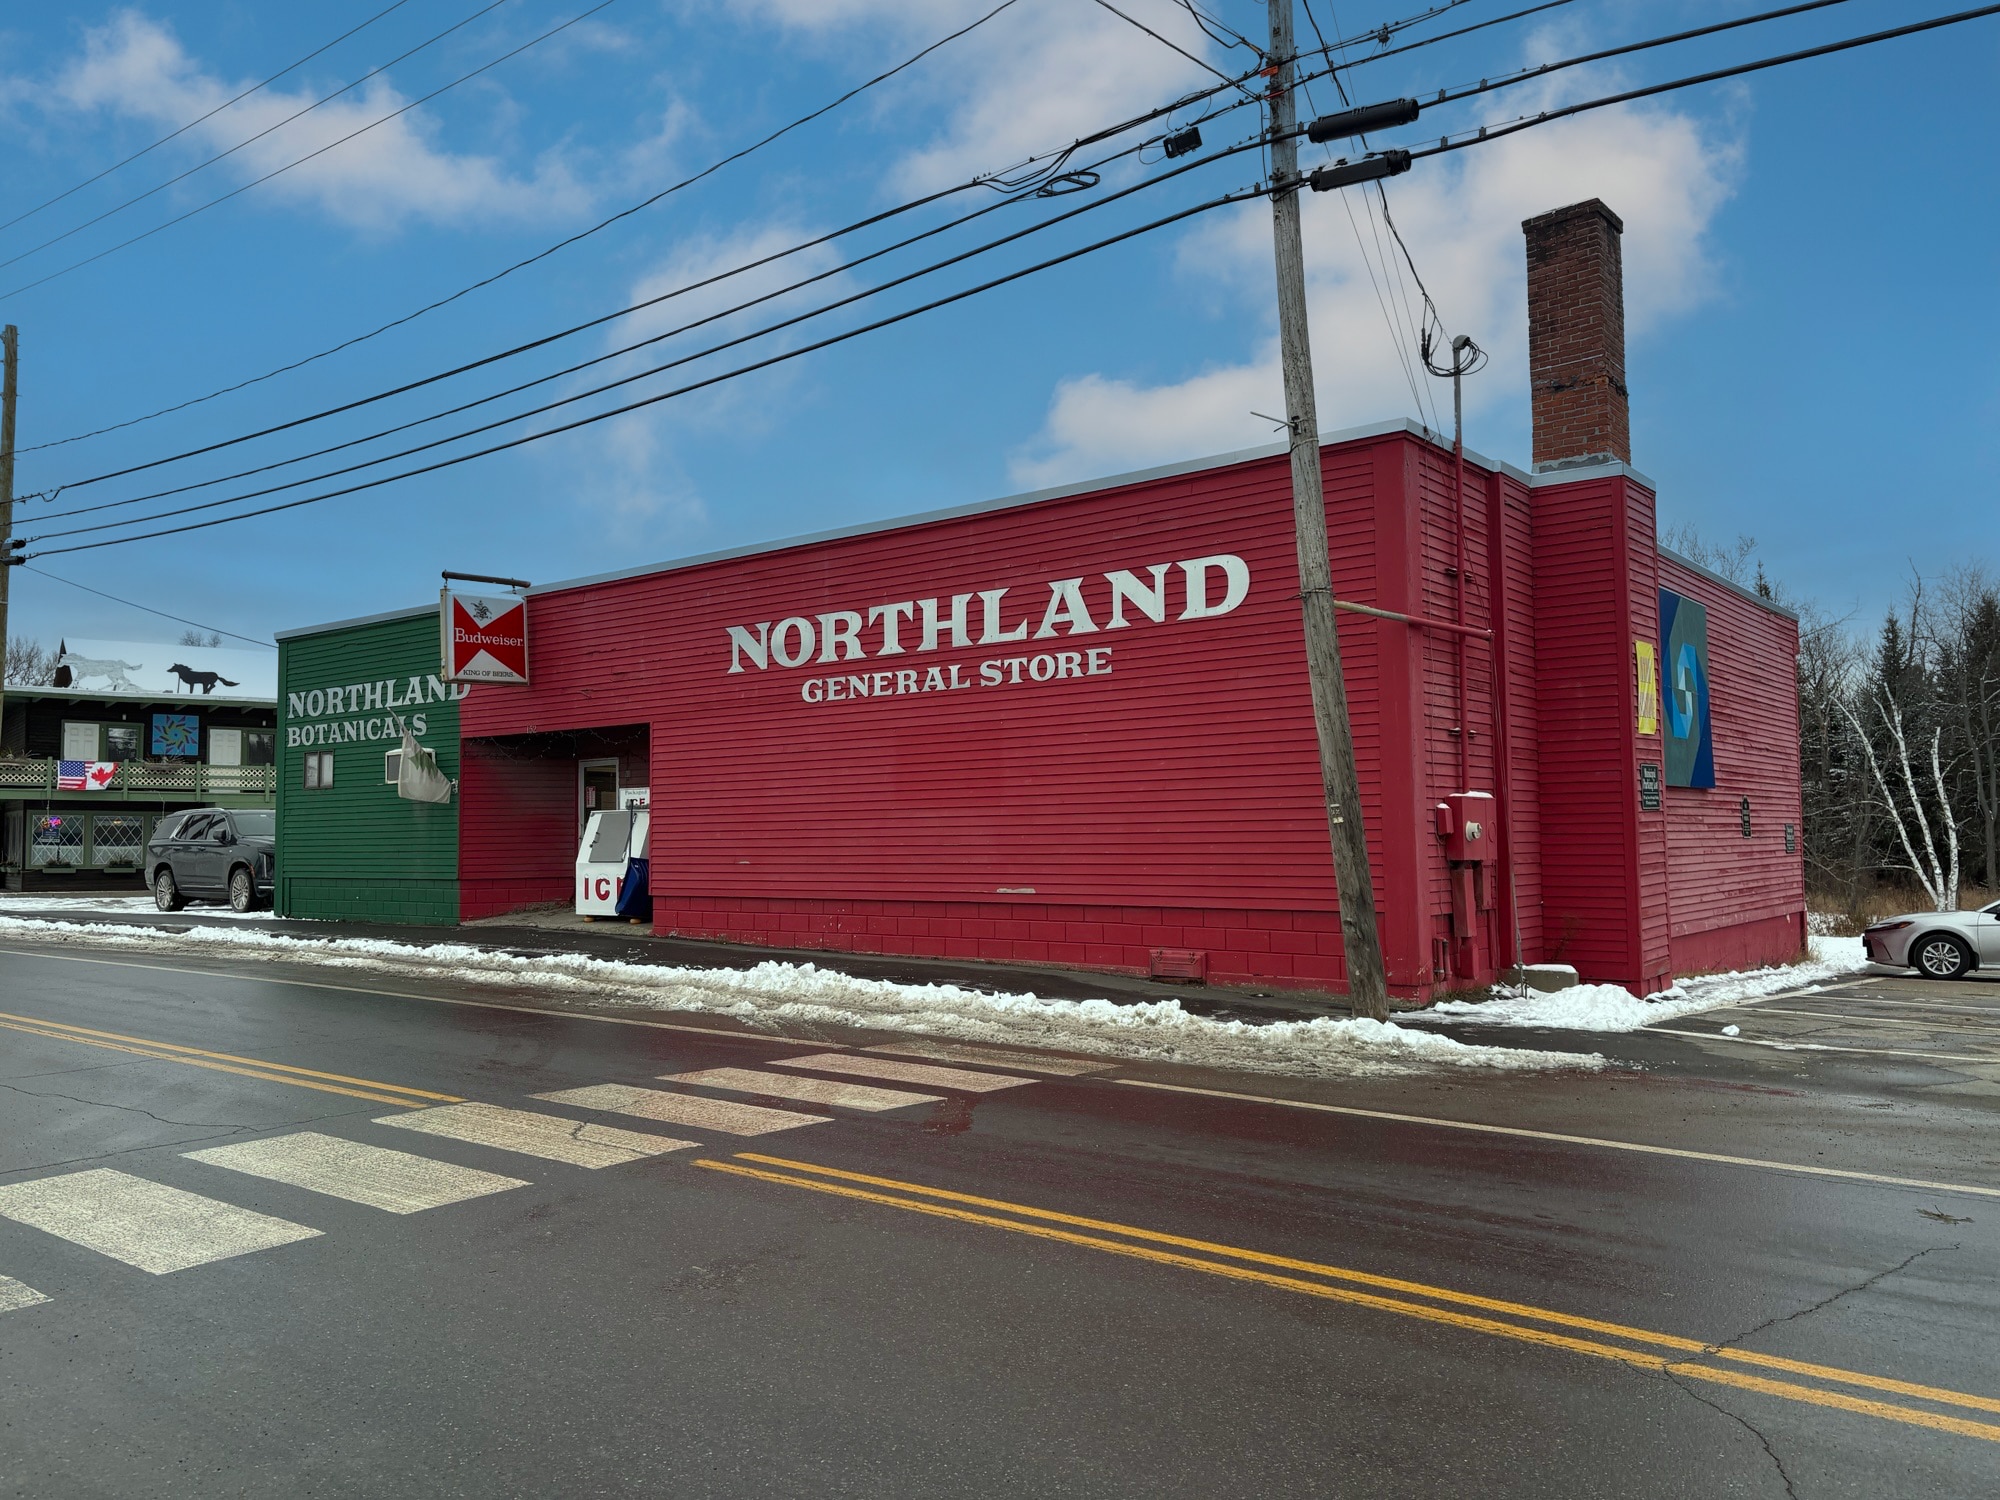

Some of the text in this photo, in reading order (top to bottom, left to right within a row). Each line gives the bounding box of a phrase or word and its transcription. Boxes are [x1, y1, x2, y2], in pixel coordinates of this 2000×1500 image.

[727, 554, 1250, 674] NORTHLAND
[454, 627, 523, 647] Budweiser
[287, 674, 472, 719] NORTHLAND
[801, 647, 1113, 703] GENERAL STORE
[287, 712, 428, 748] BOTANICALS
